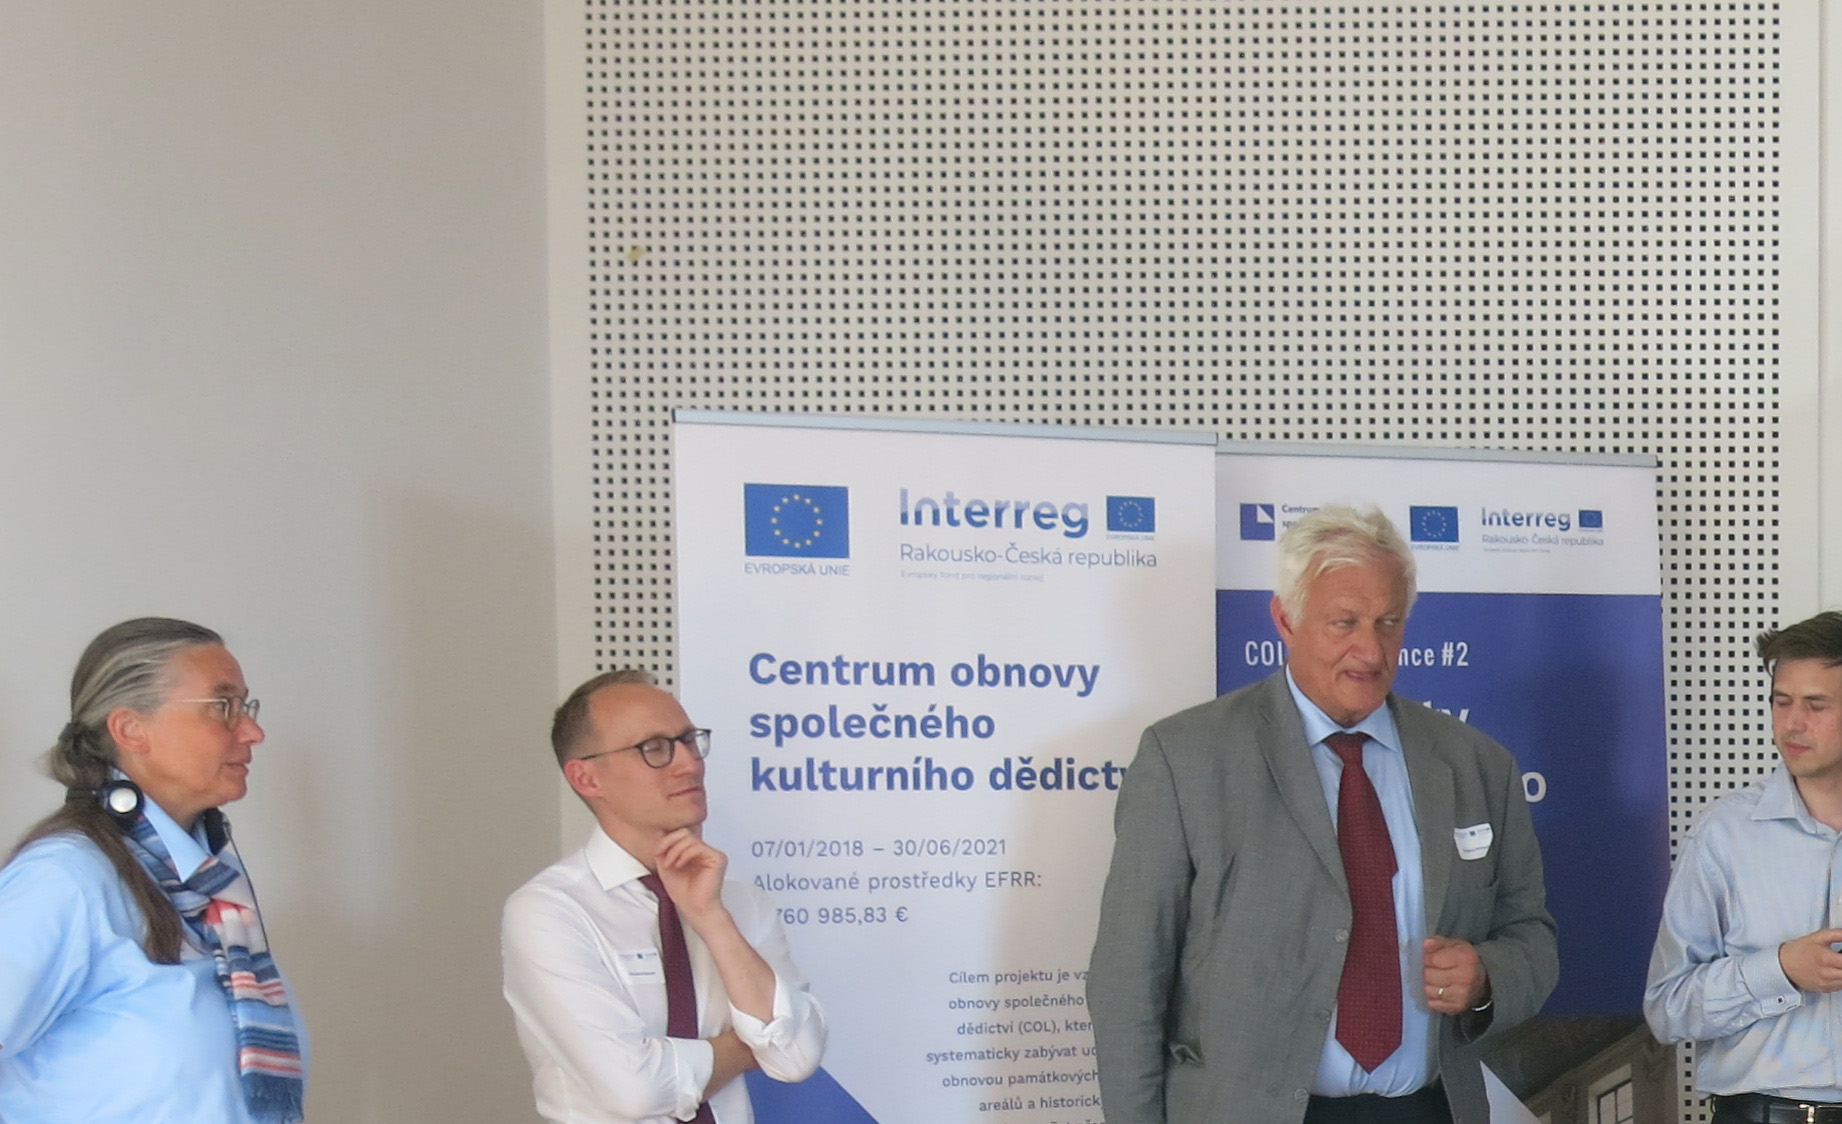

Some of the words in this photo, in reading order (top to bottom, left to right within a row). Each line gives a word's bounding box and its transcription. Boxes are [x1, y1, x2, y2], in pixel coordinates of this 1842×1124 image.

[900, 487, 1089, 539] Interreg
[1481, 507, 1571, 531] Interreg
[1069, 549, 1157, 569] republika
[744, 562, 816, 576] EVROPSKÁ
[820, 563, 850, 577] UNIE
[1442, 642, 1469, 666] #2
[749, 652, 936, 686] Centrum
[950, 654, 1101, 698] obnovy
[749, 703, 996, 748] společného
[751, 756, 974, 792] kulturního
[988, 756, 1130, 791] dědict
[751, 840, 864, 858] 07/01/2018
[893, 839, 1007, 857] 30/06/2021
[753, 871, 860, 892] Alokované
[868, 871, 977, 893] prostředky
[984, 871, 1042, 889] EFRR:
[818, 906, 887, 926] 985,83
[895, 906, 910, 923] €
[949, 971, 989, 984] Cílem
[995, 969, 1052, 986] projektu
[1057, 969, 1070, 984] je
[948, 997, 1000, 1012] obnovy
[1004, 994, 1084, 1010] společného
[957, 1020, 1014, 1035] dědictví
[1018, 1020, 1061, 1036] (COL),
[926, 1047, 1020, 1065] systematicky
[1024, 1045, 1077, 1061] zabývat
[942, 1072, 1003, 1087] obnovou
[1008, 1069, 1100, 1087] památkových
[979, 1096, 1023, 1111] areálů
[1028, 1100, 1035, 1110] a
[1040, 1095, 1103, 1110] historick
